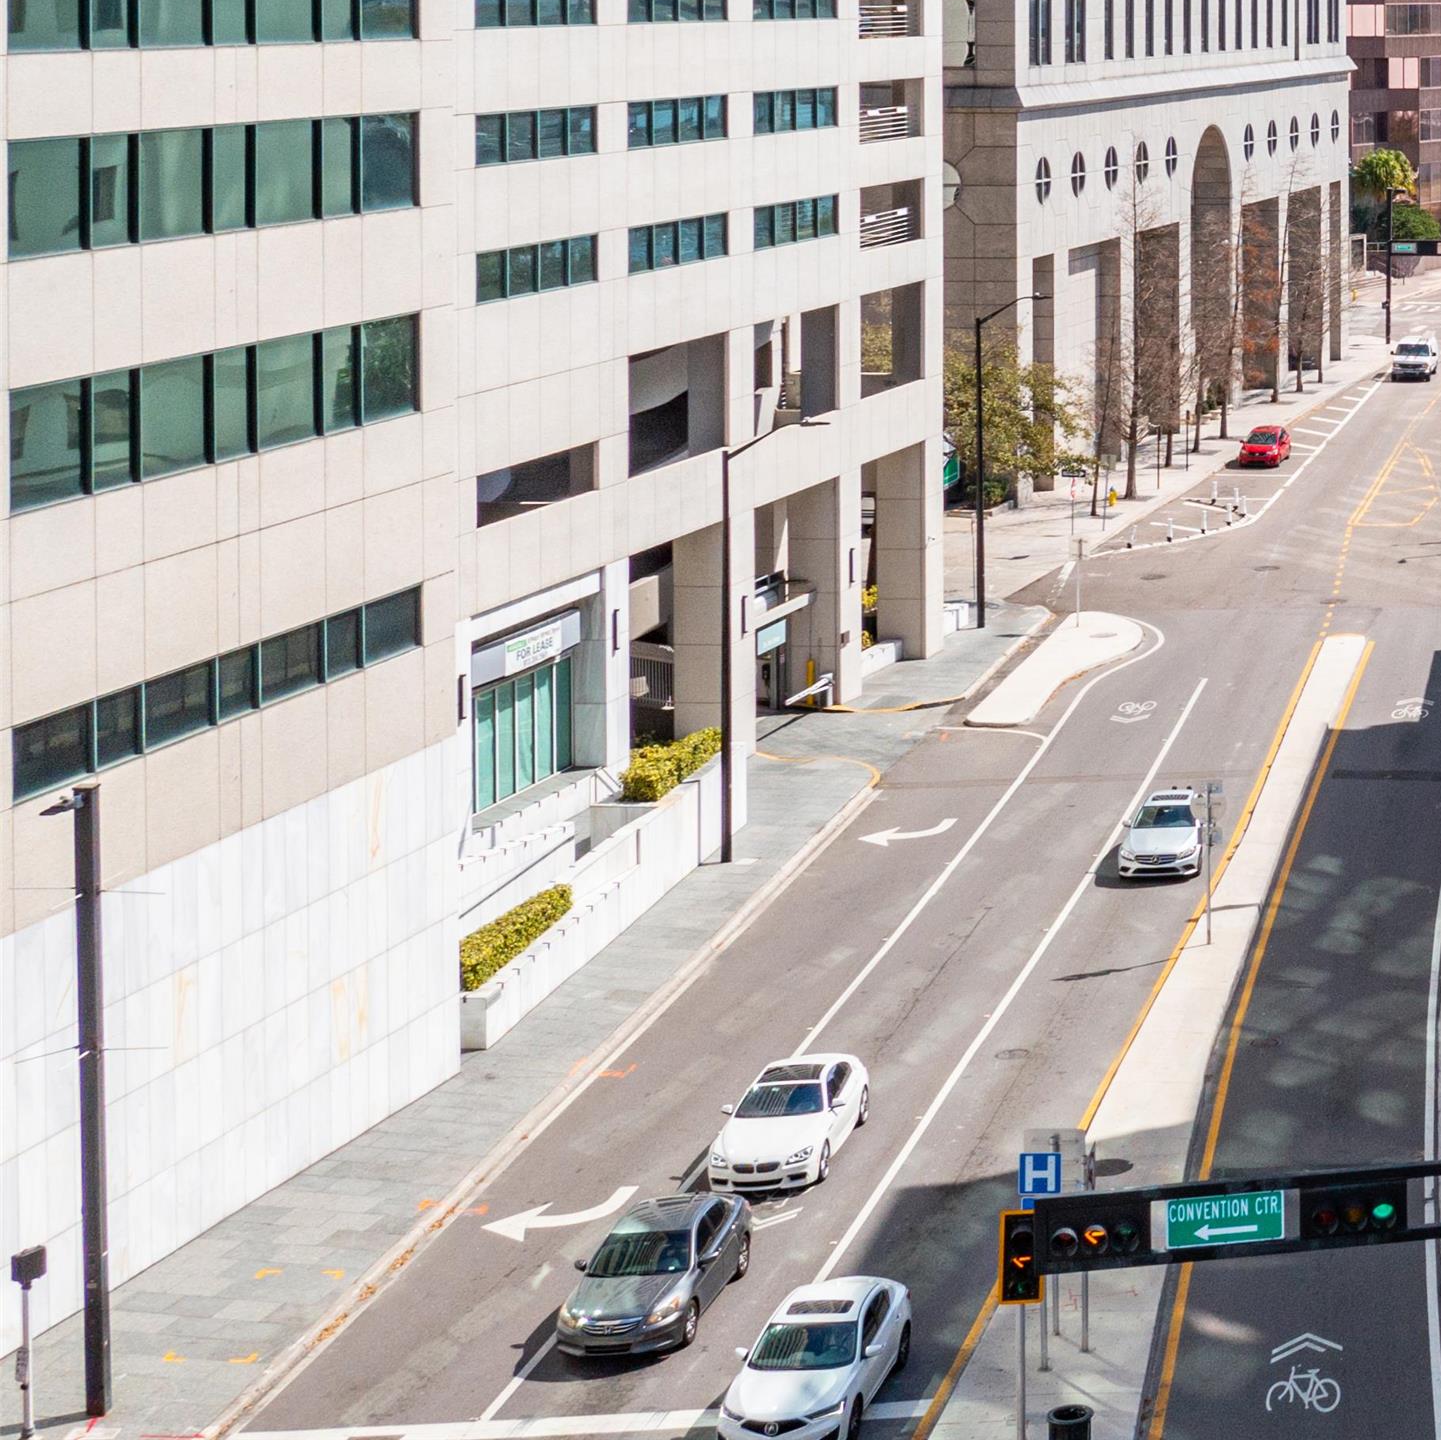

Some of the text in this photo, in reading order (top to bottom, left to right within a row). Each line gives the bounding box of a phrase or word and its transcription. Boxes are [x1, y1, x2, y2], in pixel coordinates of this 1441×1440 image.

[516, 646, 531, 661] FOR
[532, 637, 553, 655] LEASE
[1024, 1155, 1056, 1192] H
[1169, 1198, 1249, 1223] CONVENTION
